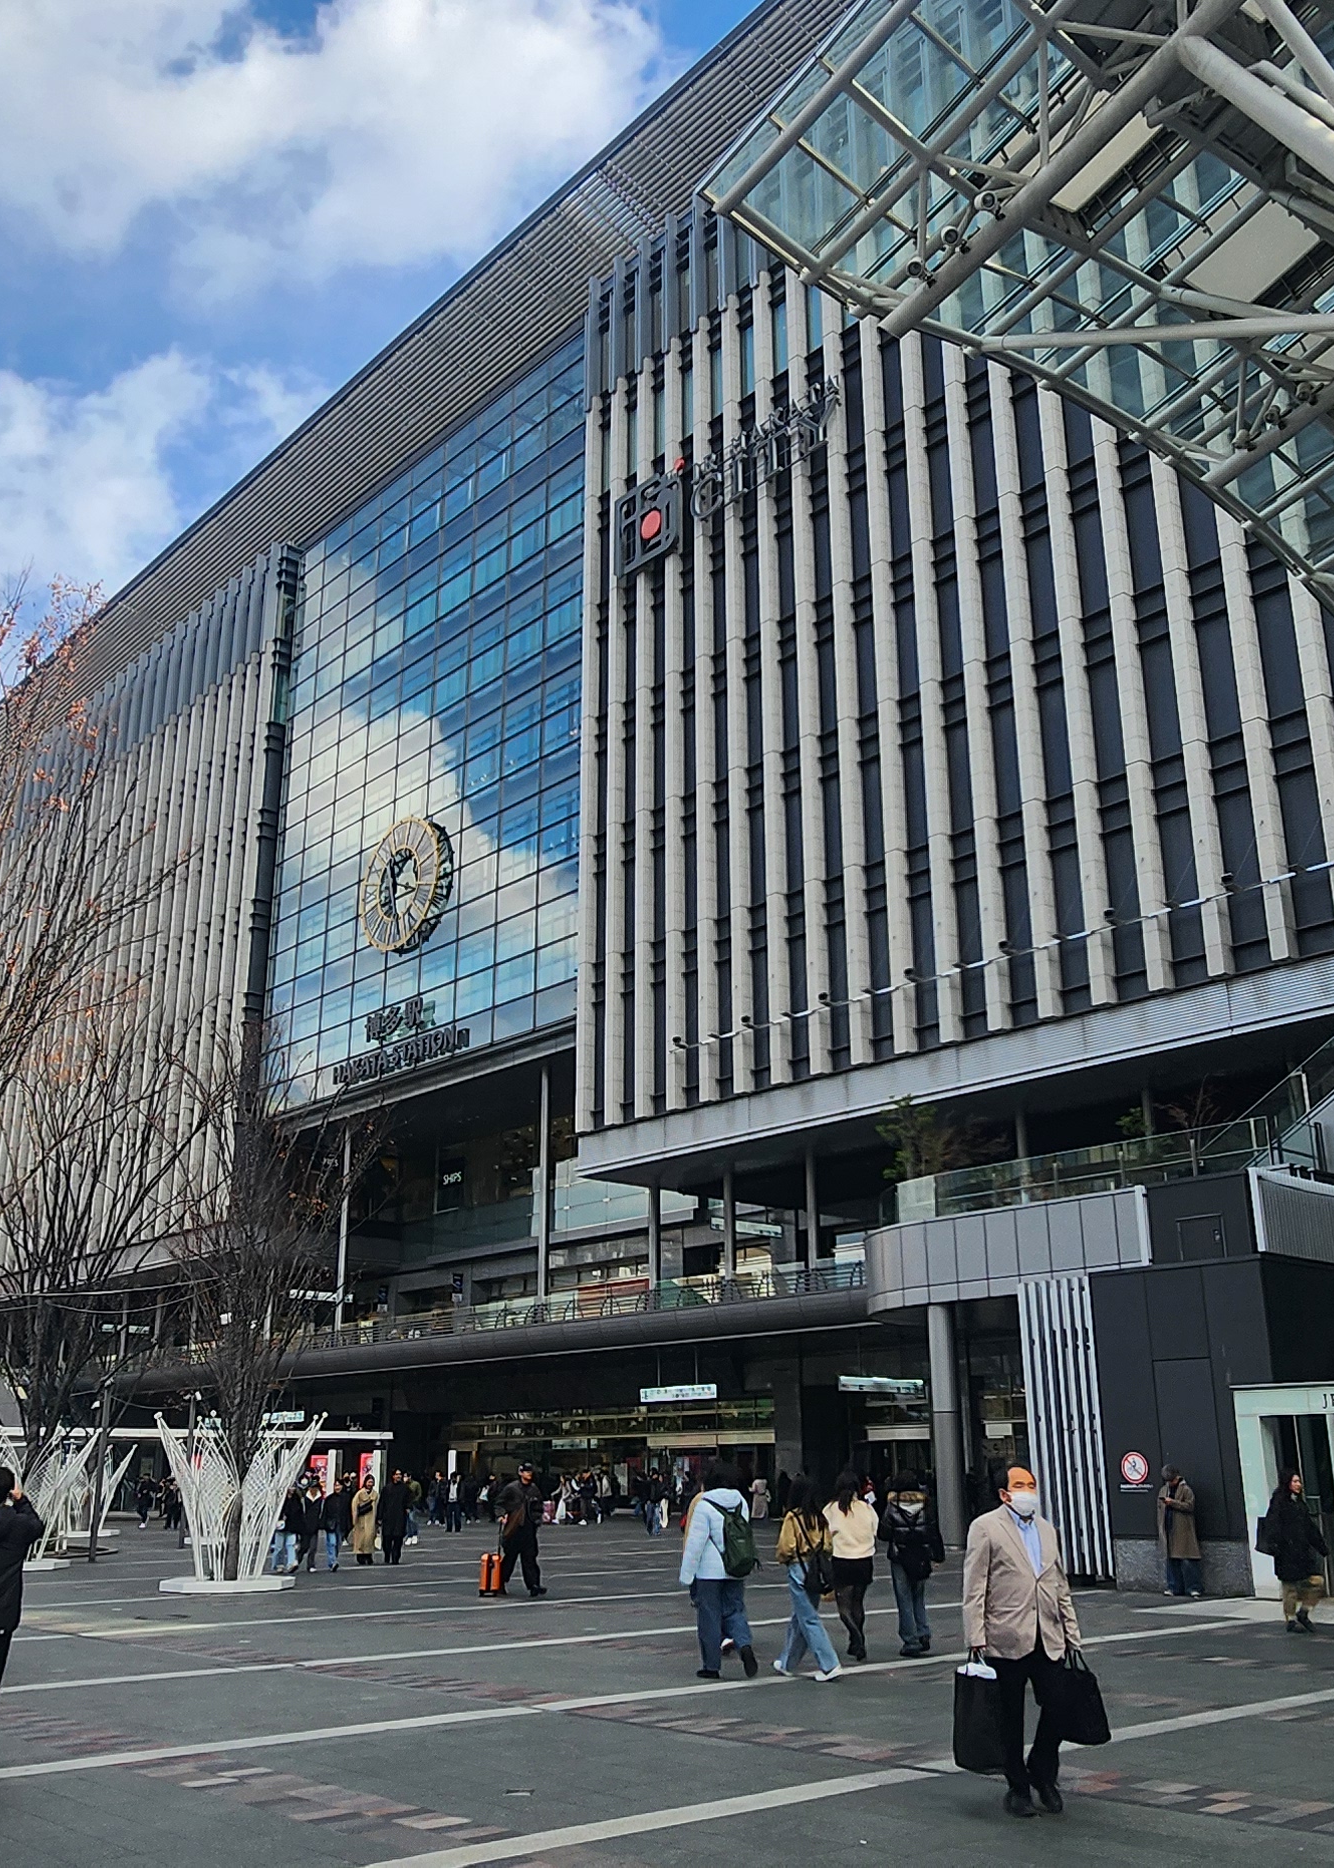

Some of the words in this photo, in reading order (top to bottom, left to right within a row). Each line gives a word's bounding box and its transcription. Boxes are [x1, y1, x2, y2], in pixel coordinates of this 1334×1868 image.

[690, 395, 842, 521] CITY
[365, 995, 425, 1044] 博多駅
[333, 1050, 390, 1085] HAKATA
[391, 1024, 457, 1069] STATION
[443, 1171, 462, 1186] SHIPS
